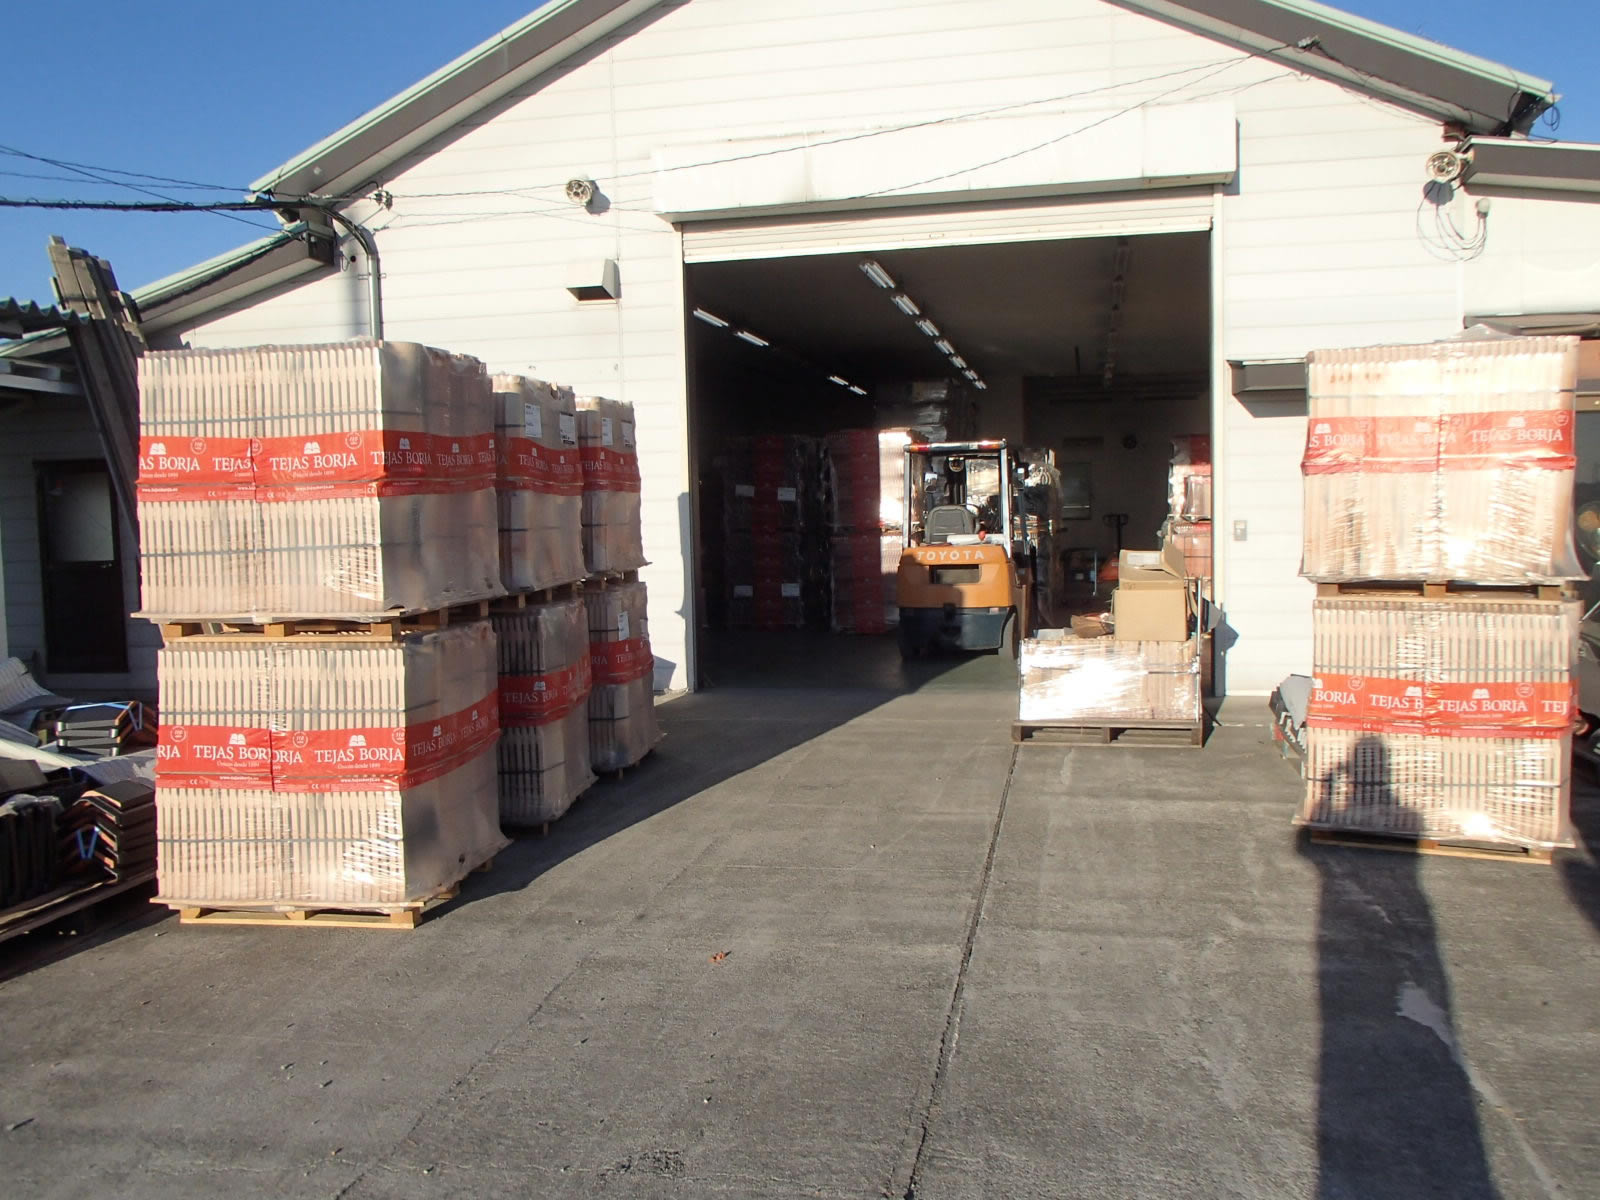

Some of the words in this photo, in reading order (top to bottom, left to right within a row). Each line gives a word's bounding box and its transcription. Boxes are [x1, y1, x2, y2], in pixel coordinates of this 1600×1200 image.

[1517, 428, 1563, 443] BORJA
[159, 456, 200, 472] BORJA
[270, 456, 309, 472] TEJAS
[314, 453, 358, 470] BORJA
[917, 550, 985, 561] TOYOTA
[1315, 689, 1357, 705] BORJA
[1369, 694, 1409, 709] TEJAS
[1437, 699, 1477, 713] TEJAS
[1482, 699, 1528, 713] BORJA
[193, 745, 234, 760] TEJAS
[314, 748, 354, 764] TEJAS
[360, 747, 404, 763] BORJA
